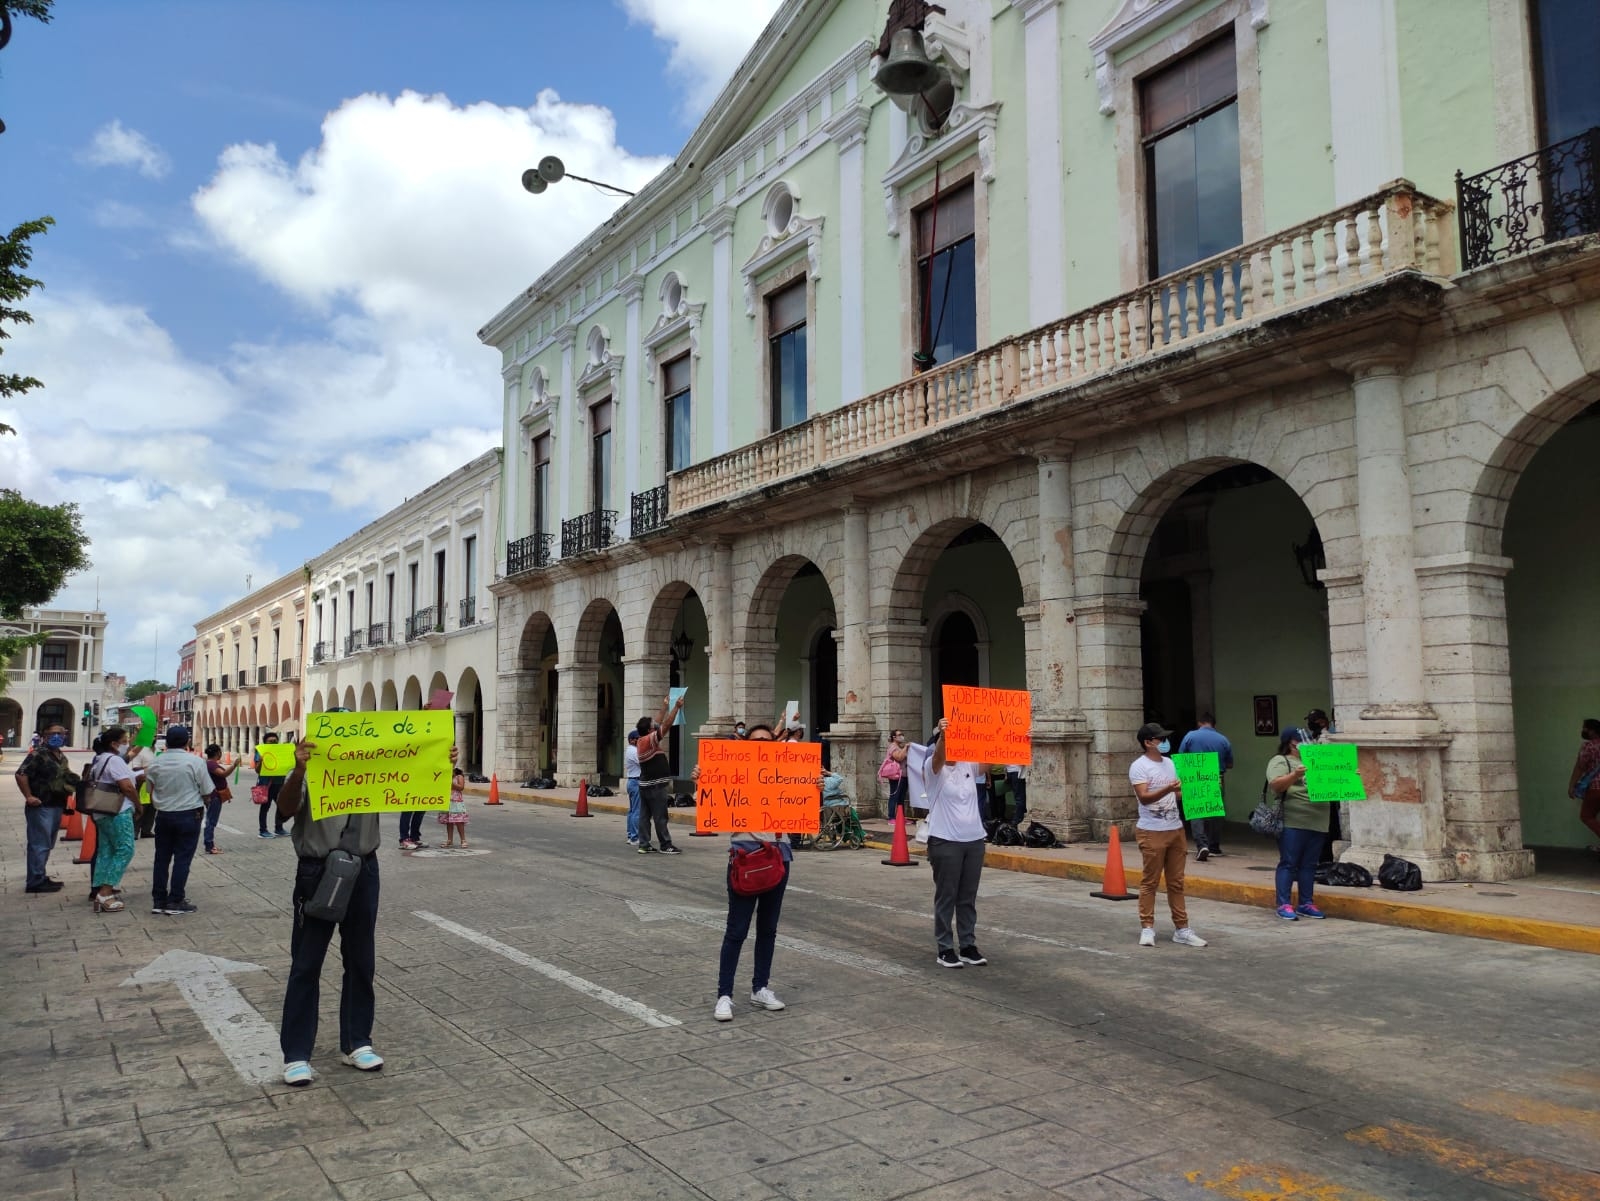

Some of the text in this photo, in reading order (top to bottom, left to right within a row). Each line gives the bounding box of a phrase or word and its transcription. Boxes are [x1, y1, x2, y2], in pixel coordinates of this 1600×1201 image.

[948, 687, 1029, 709] GOBERNADOR
[951, 706, 1024, 726] Mauricio Vila
[316, 716, 379, 738] Basta
[702, 741, 751, 761] Pedimos
[758, 745, 769, 762] la
[322, 769, 410, 789] NEPOTISMO
[699, 767, 819, 785] ción del Gobernado
[320, 796, 371, 816] FAVORES
[699, 788, 813, 808] M. Vila a favor
[703, 811, 819, 831] de los Docentes
